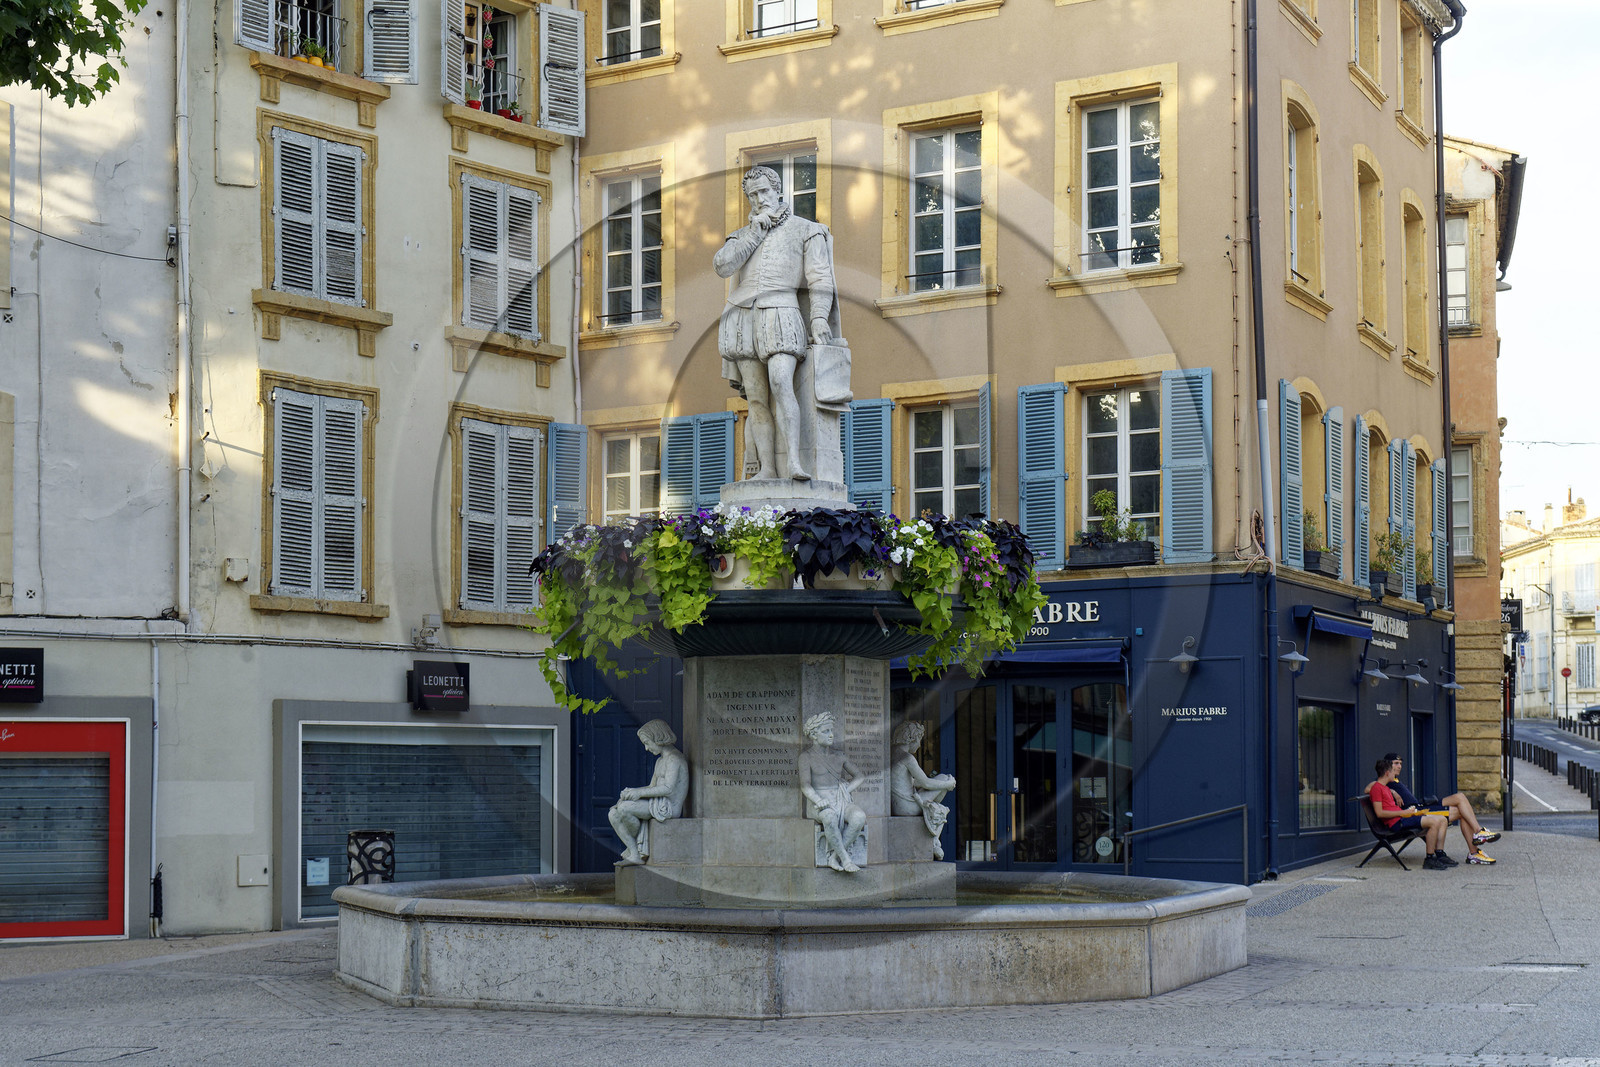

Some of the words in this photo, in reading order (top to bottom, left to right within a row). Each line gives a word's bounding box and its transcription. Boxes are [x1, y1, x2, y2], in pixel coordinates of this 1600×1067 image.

[2, 677, 35, 689] opticien
[423, 675, 465, 687] LEONETTI
[442, 688, 464, 698] opticien
[706, 691, 730, 700] ADAM
[731, 690, 744, 699] DE
[746, 689, 797, 698] CRAPPONNE
[726, 703, 777, 711] INGENIEVR
[1161, 707, 1197, 716] MARIUS
[1198, 706, 1228, 716] FABRE
[726, 716, 753, 724] SALON
[754, 715, 765, 723] EN
[766, 715, 798, 723] MDXXV
[712, 728, 736, 736] MORT
[737, 728, 749, 736] EN
[751, 727, 792, 735] MDLXXVI
